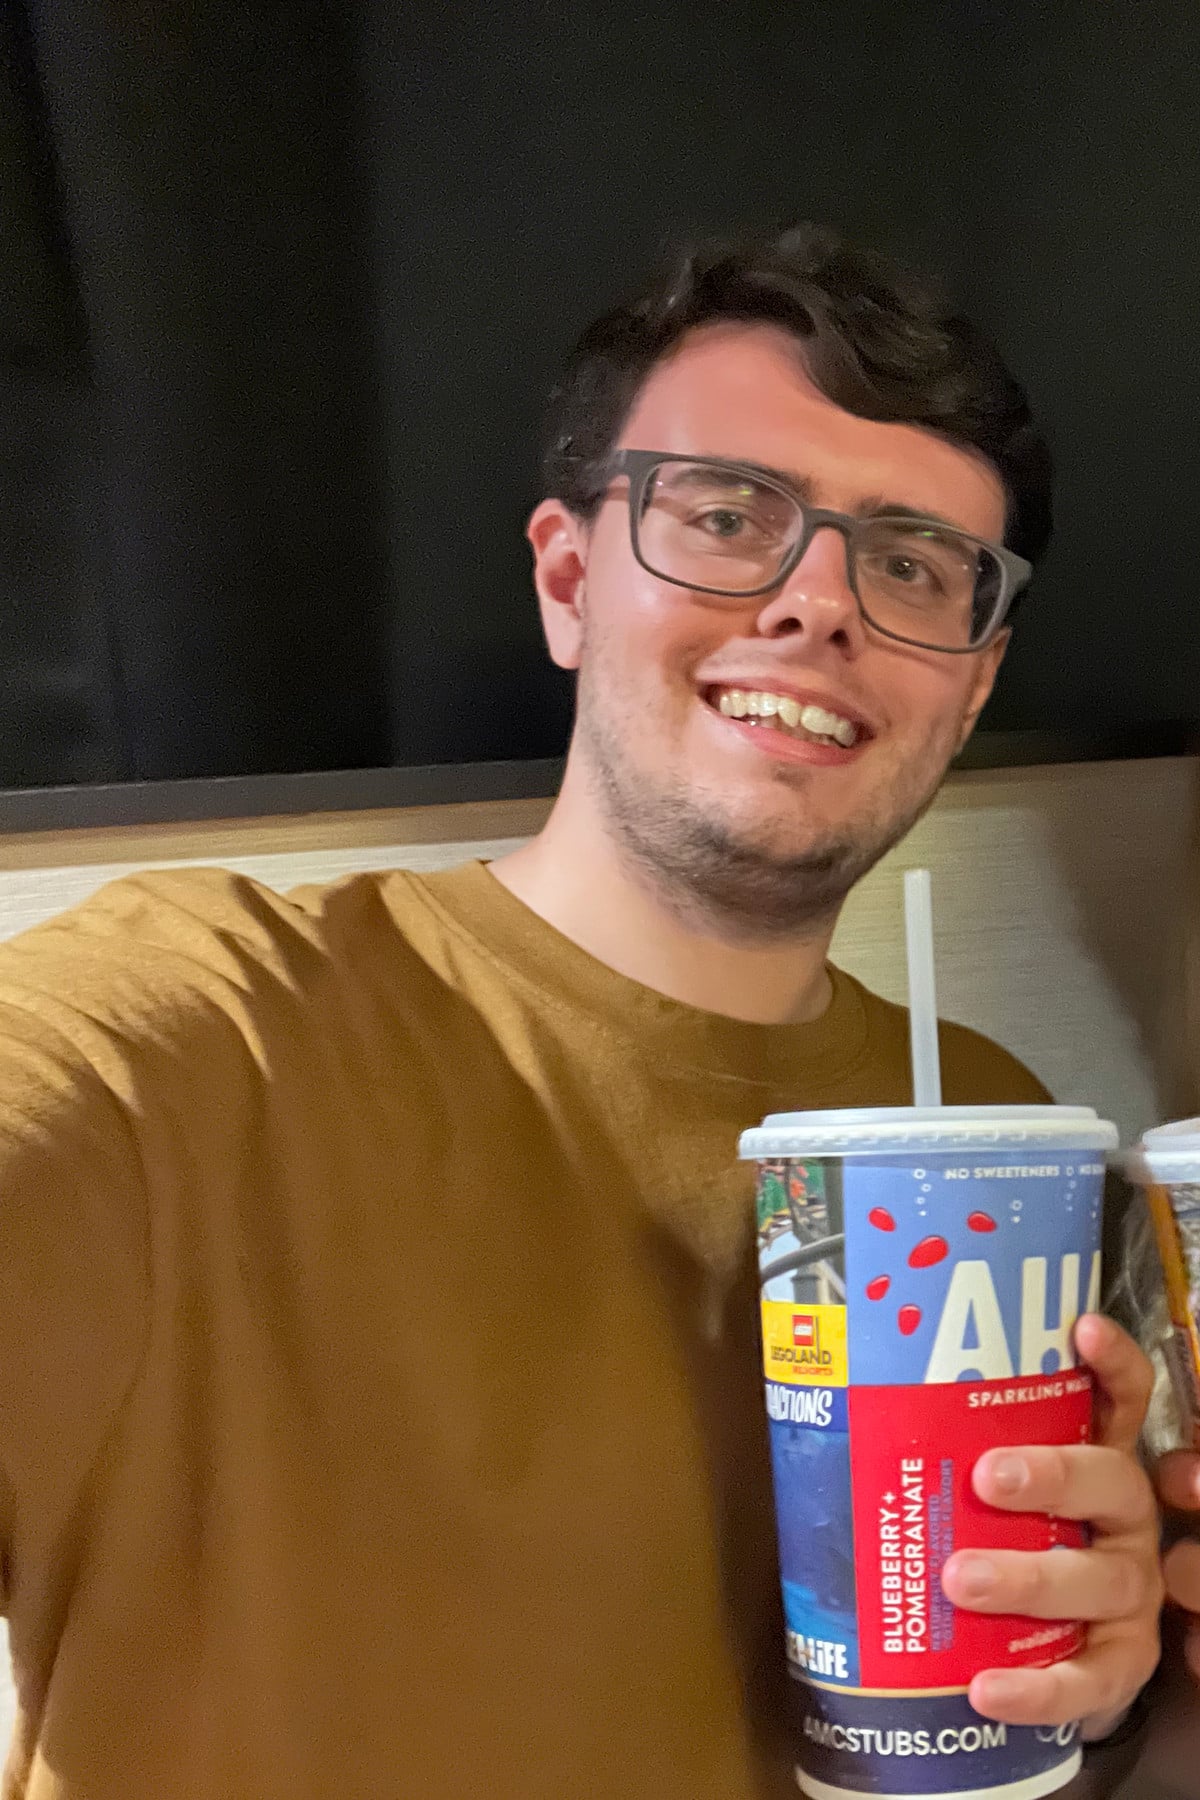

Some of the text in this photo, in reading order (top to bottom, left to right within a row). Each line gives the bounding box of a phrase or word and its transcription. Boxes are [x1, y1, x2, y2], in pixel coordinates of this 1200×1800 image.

[924, 1250, 1101, 1383] AH
[968, 1381, 1063, 1408] SPARKLING
[901, 1458, 927, 1652] POMEGRANATE
